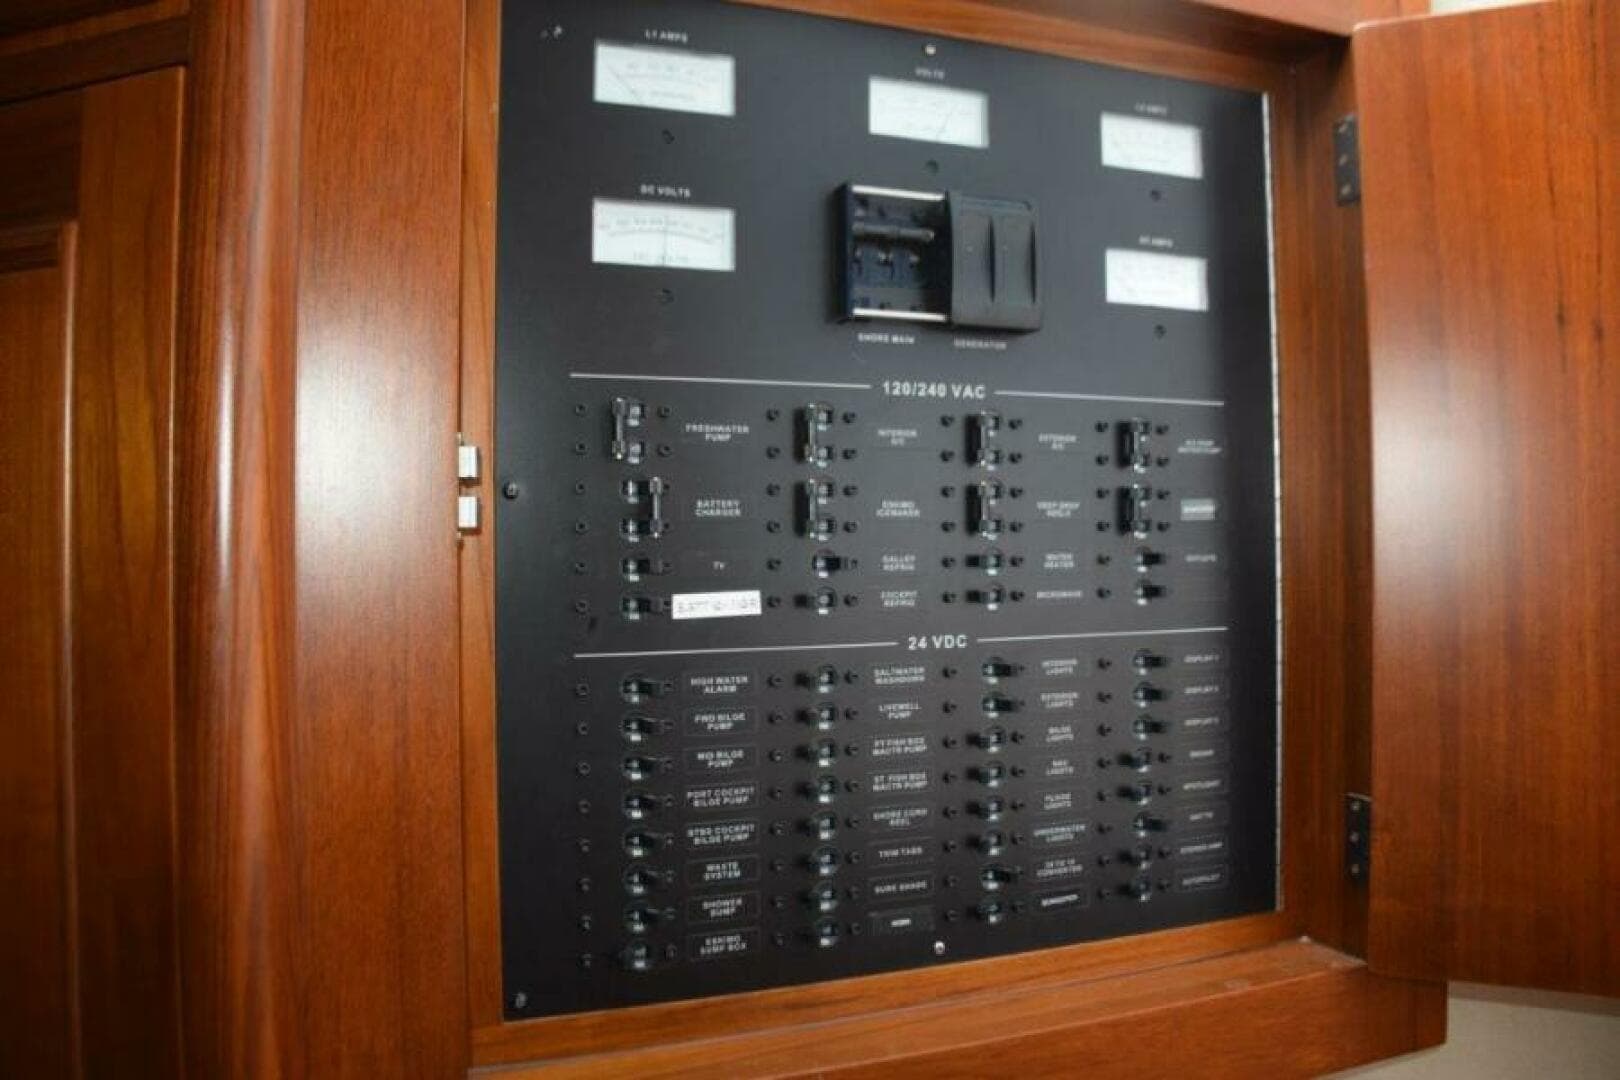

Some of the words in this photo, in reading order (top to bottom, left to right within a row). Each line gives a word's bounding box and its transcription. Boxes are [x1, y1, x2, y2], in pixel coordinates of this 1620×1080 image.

[660, 31, 689, 43] AMPS
[657, 186, 691, 198] VOLTS
[892, 335, 915, 345] MAIN
[882, 381, 946, 397] 120/240
[951, 384, 986, 399] VAC
[685, 423, 749, 434] FRESHWATER
[705, 433, 731, 442] PUMP
[697, 499, 740, 509] BATTERY
[695, 508, 741, 517] CHARGER
[907, 636, 928, 650] 24
[931, 634, 968, 649] VDC
[690, 677, 714, 686] HIGH
[716, 676, 748, 685] WATER
[704, 685, 737, 694] ALARM
[717, 712, 746, 722] BILGE
[888, 711, 912, 720] PUMP
[707, 722, 734, 731] PUMP
[716, 750, 744, 759] BILGE
[707, 759, 734, 768] PUMP
[687, 789, 714, 799] PORT
[715, 786, 755, 797] COCKPIT
[693, 797, 720, 807] BILGE
[722, 795, 749, 805] PUMP
[714, 823, 755, 834] COCKPIT
[694, 836, 721, 845] BILGE
[723, 832, 749, 842] PUMP
[878, 849, 899, 858] TRIM
[901, 846, 922, 856] TABS
[705, 861, 739, 872] WASTE
[703, 870, 741, 881] SYSTEM
[702, 898, 742, 910] SHOWER
